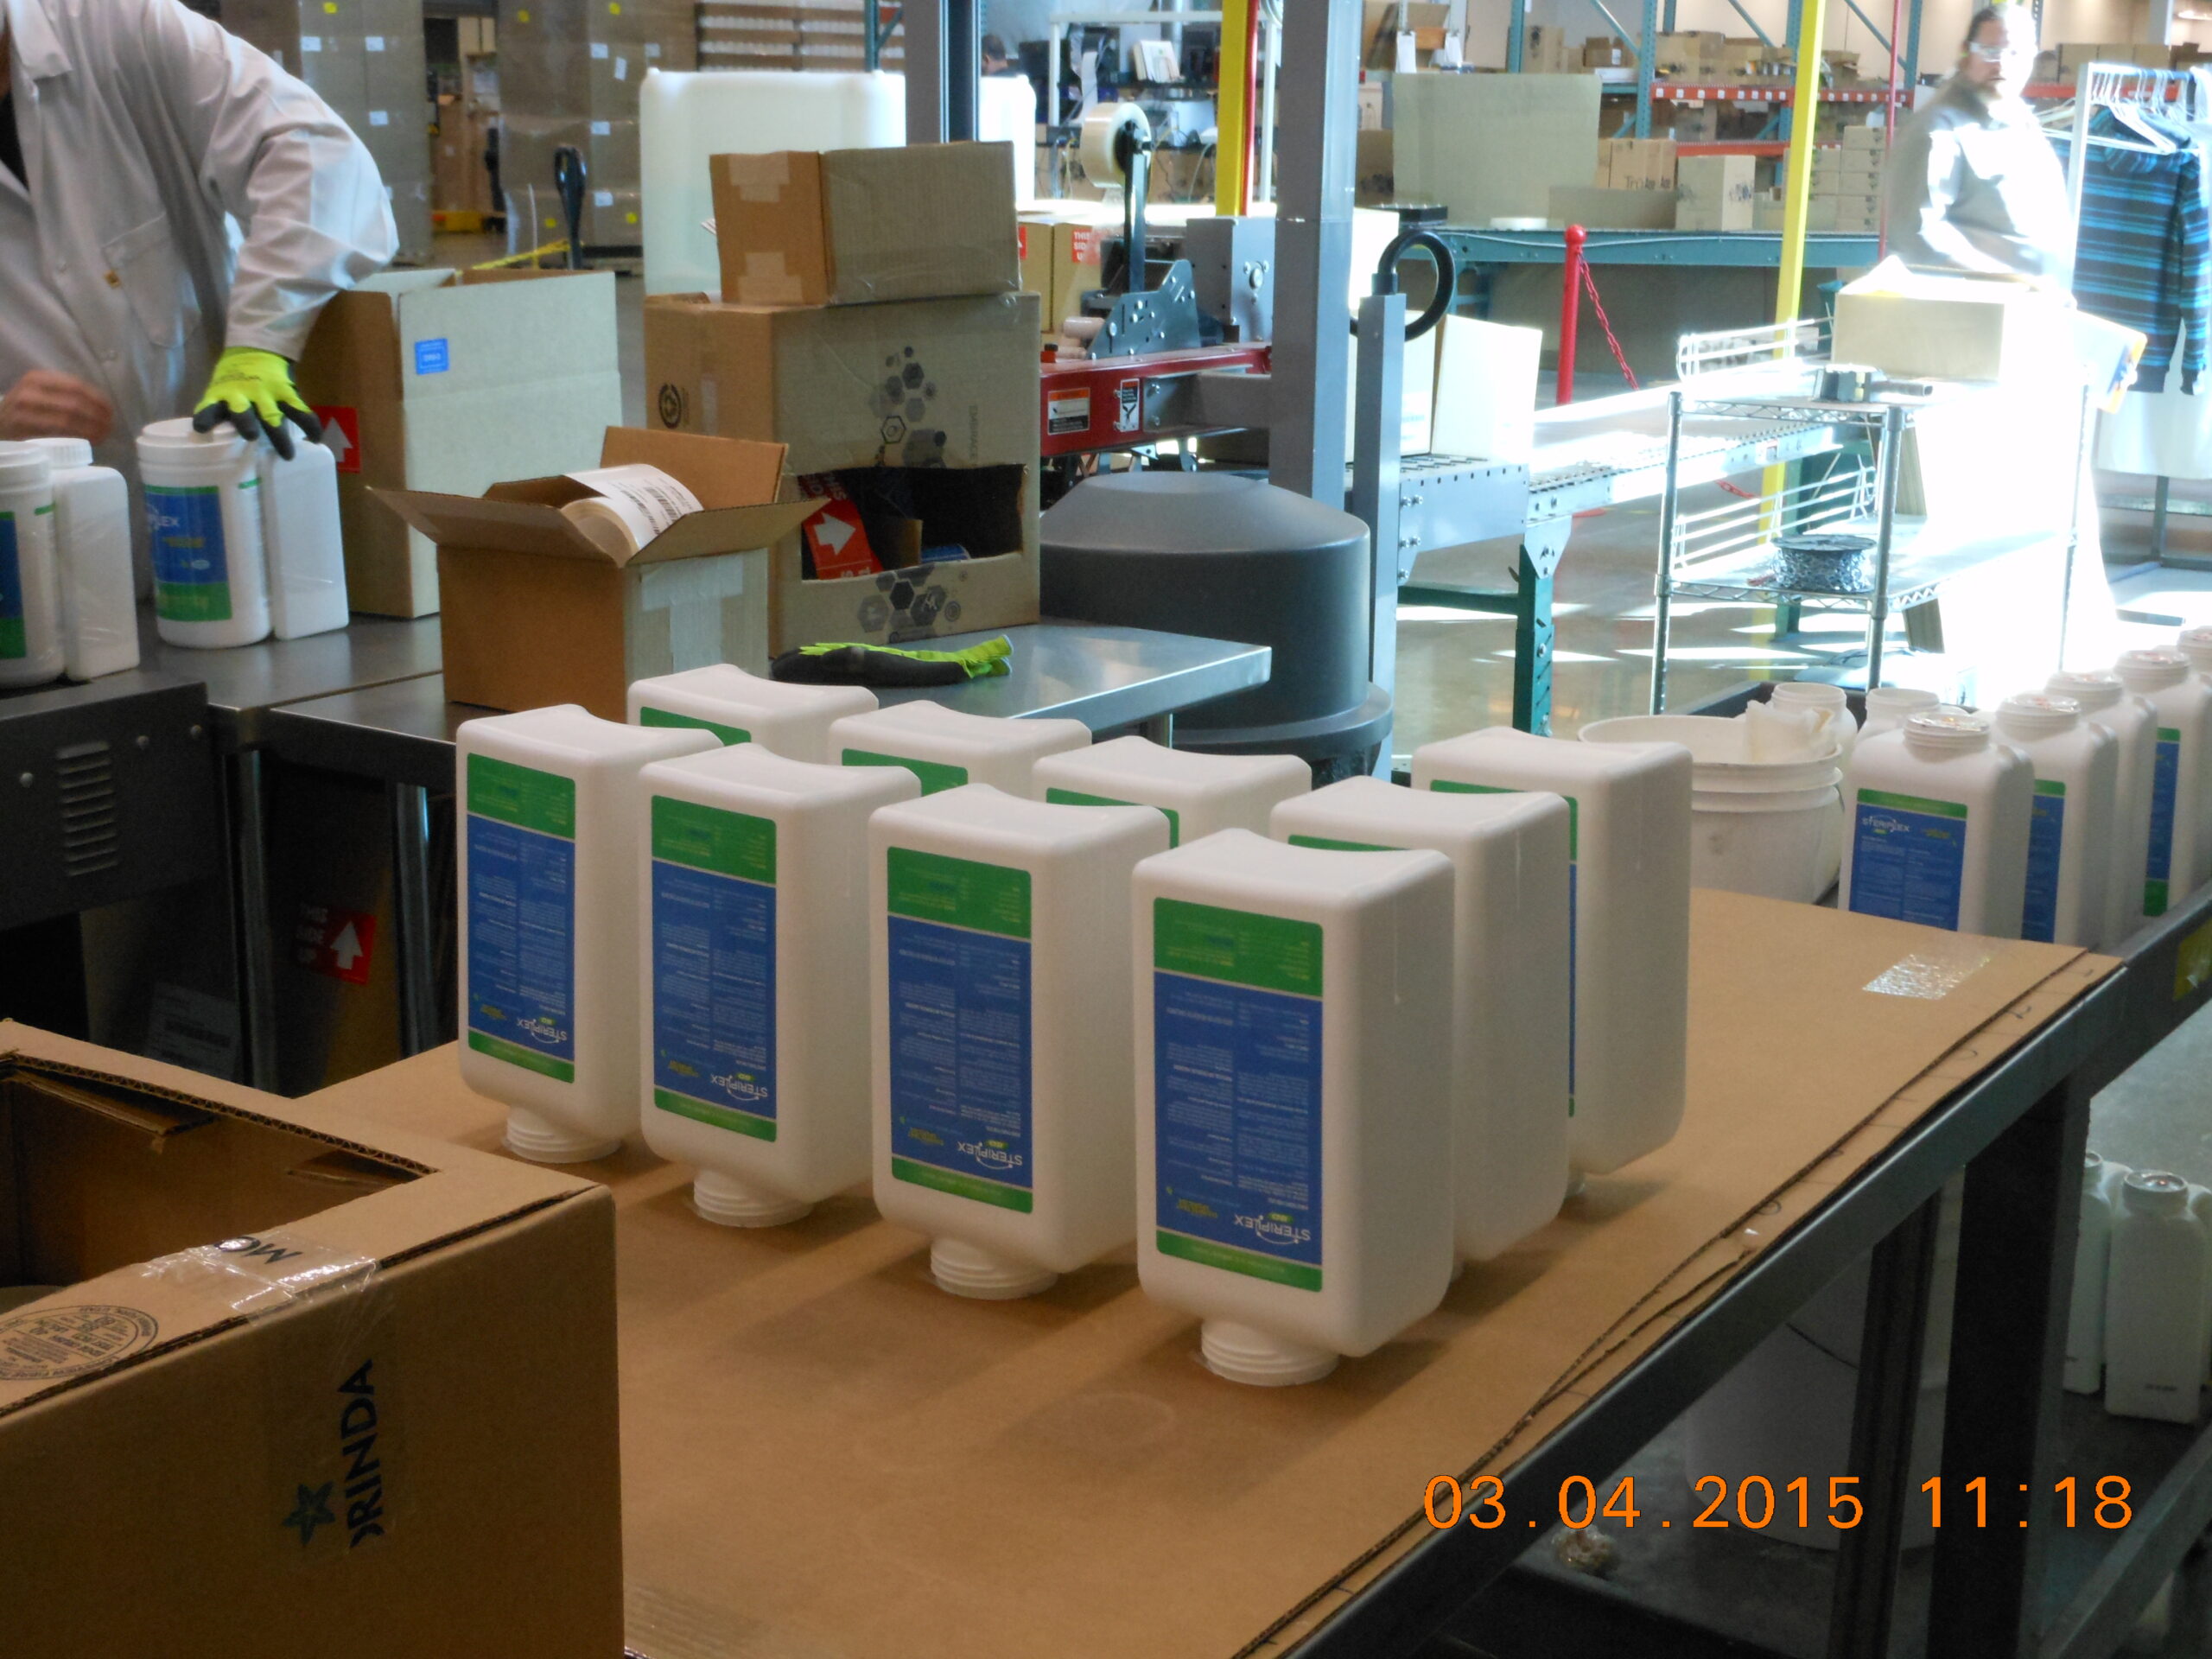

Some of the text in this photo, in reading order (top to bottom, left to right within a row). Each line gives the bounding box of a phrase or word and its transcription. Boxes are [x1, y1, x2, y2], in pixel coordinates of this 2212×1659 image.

[516, 1018, 568, 1042] STERIPLEX
[710, 1073, 768, 1099] STERIPLEX
[957, 1141, 1023, 1167] STERIPLEX
[1233, 1213, 1312, 1243] STERIPLEX
